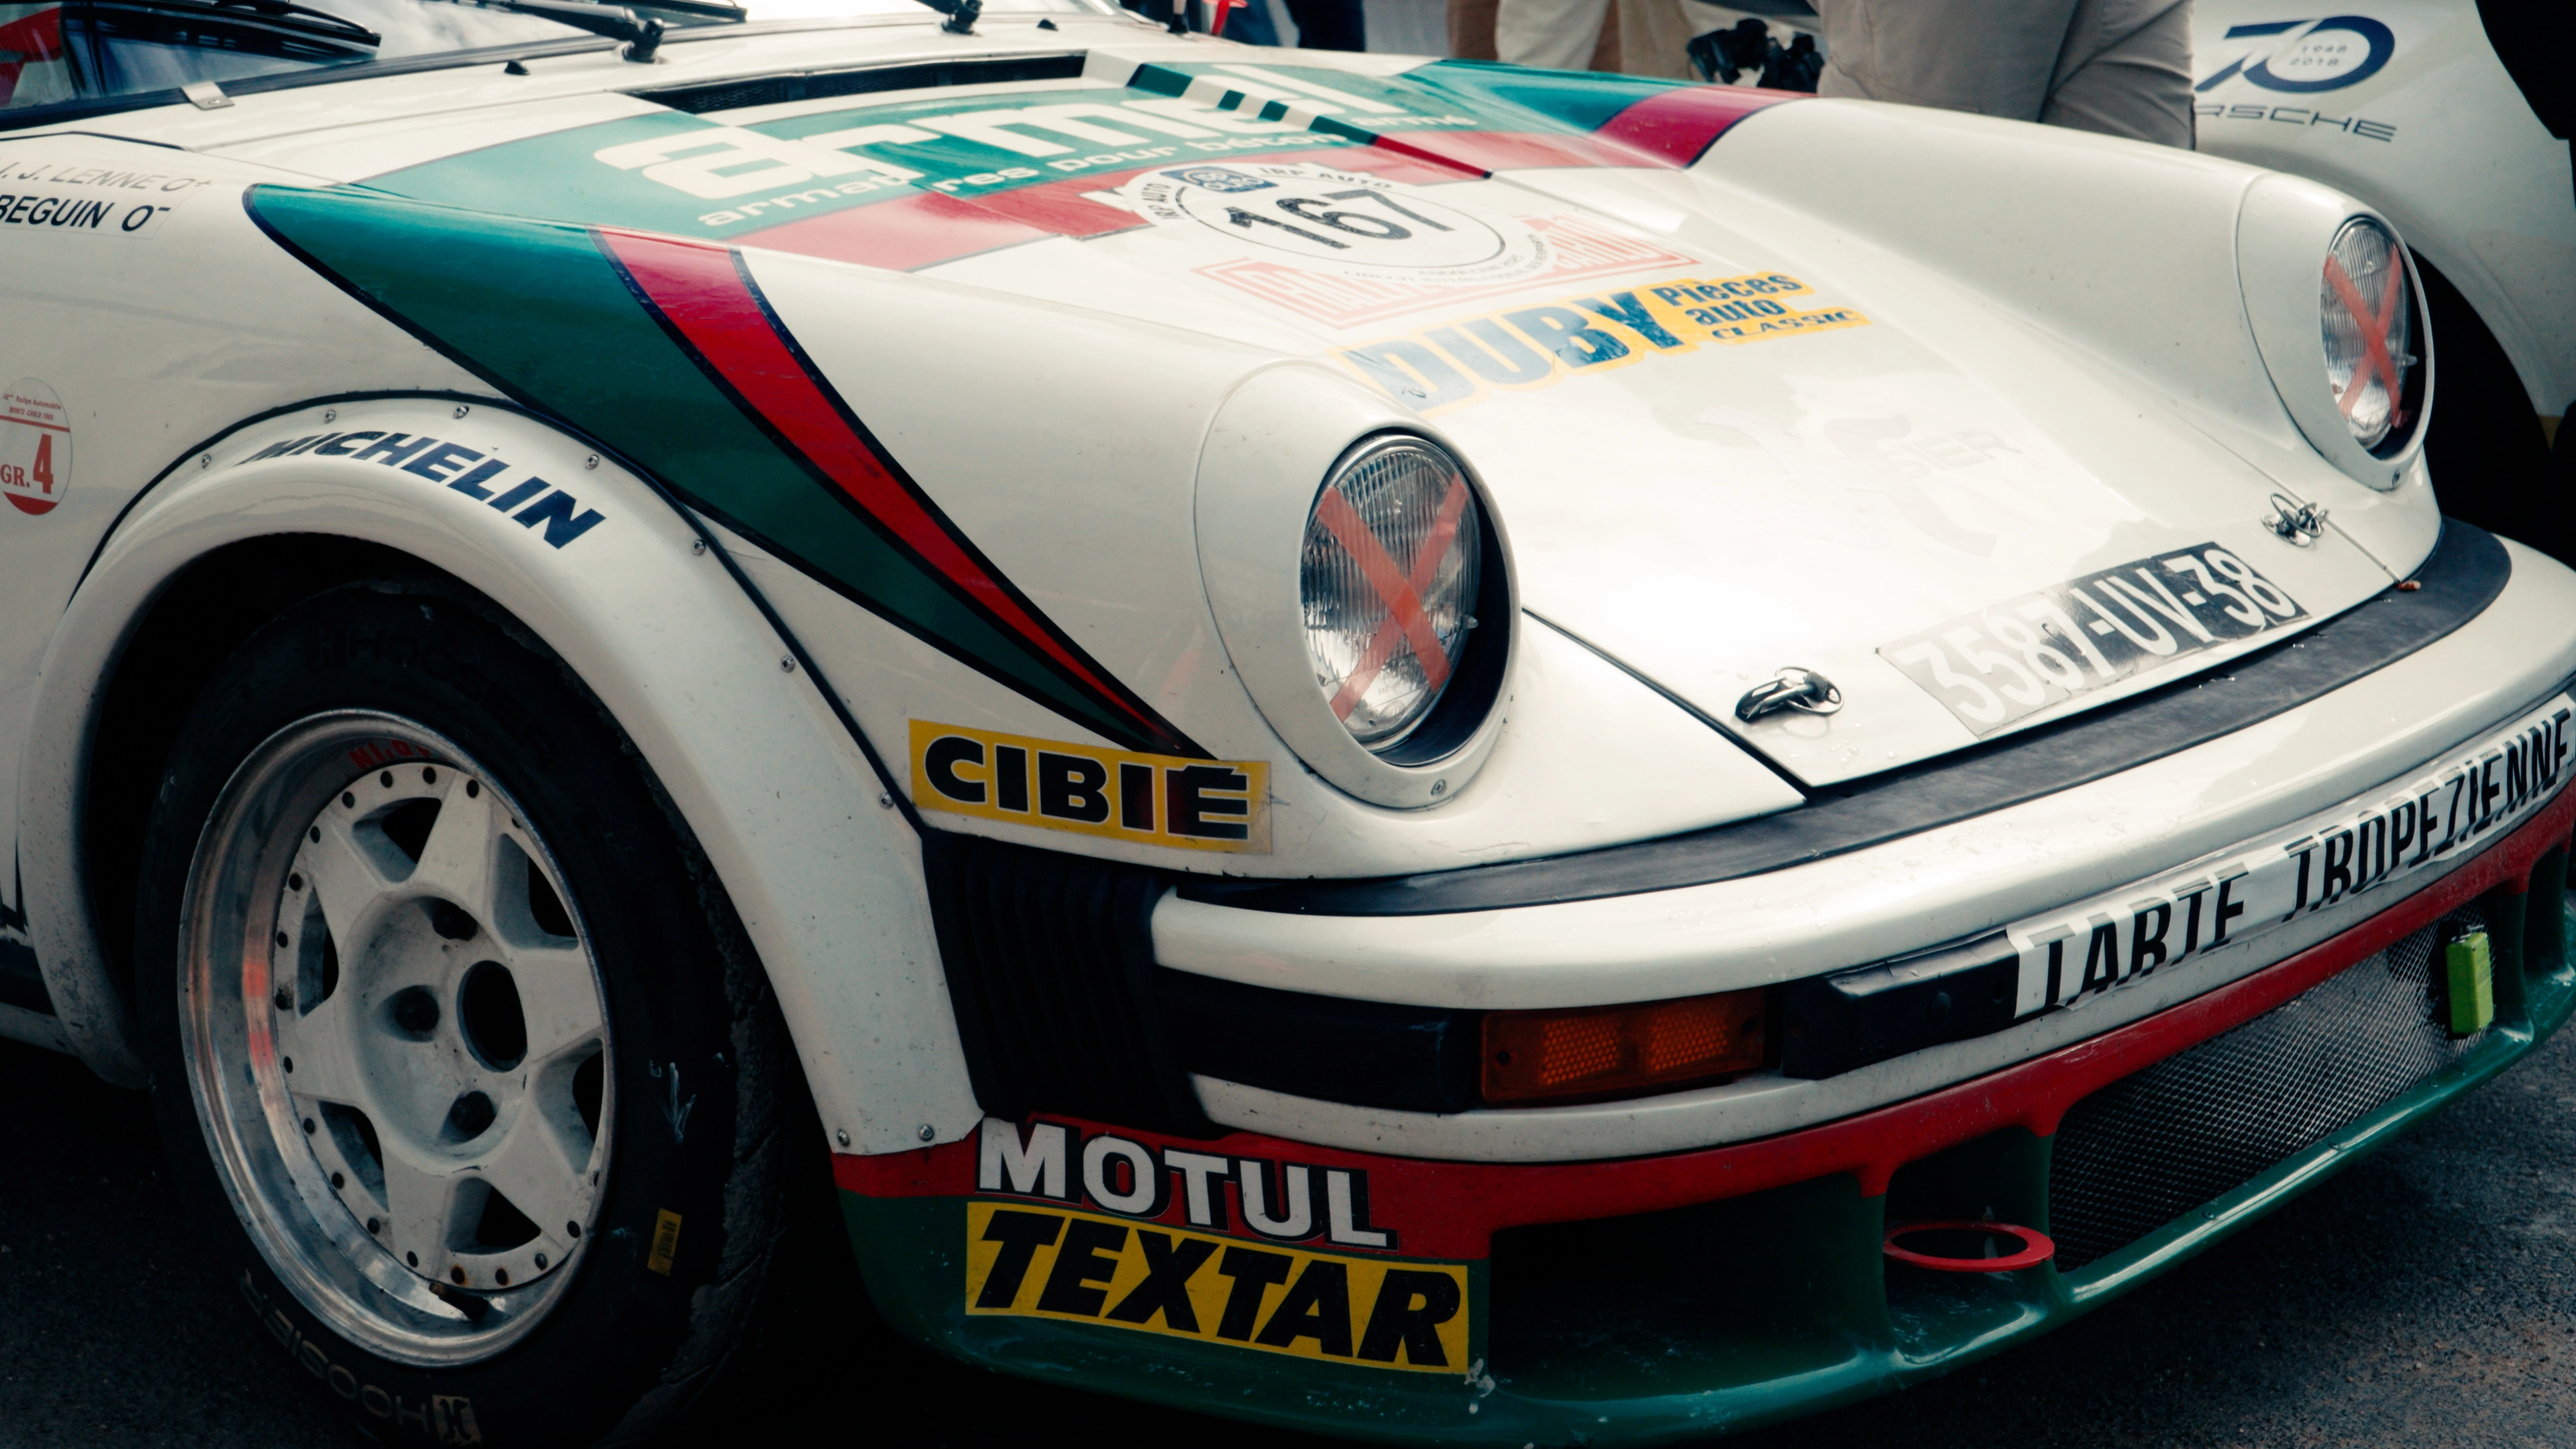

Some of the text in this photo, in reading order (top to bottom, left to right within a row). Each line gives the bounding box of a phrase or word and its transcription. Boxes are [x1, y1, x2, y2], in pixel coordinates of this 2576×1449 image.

[49, 168, 168, 189] LENNE
[1046, 146, 1179, 171] pour
[0, 195, 116, 229] BEGUIN
[1226, 189, 1456, 249] 167
[1346, 274, 1803, 413] DUBY Pièces
[1684, 299, 1787, 326] auto
[1712, 310, 1860, 340] CLASSIC
[1, 433, 54, 495] GR. 4
[233, 431, 606, 549] MICHELIN
[1892, 549, 2296, 724] 3587-UV-38
[2027, 707, 2571, 1008] TARTE TROPEZIENNE
[976, 1118, 1398, 1251] MOTUL
[975, 1210, 1461, 1367] TEXTAR
